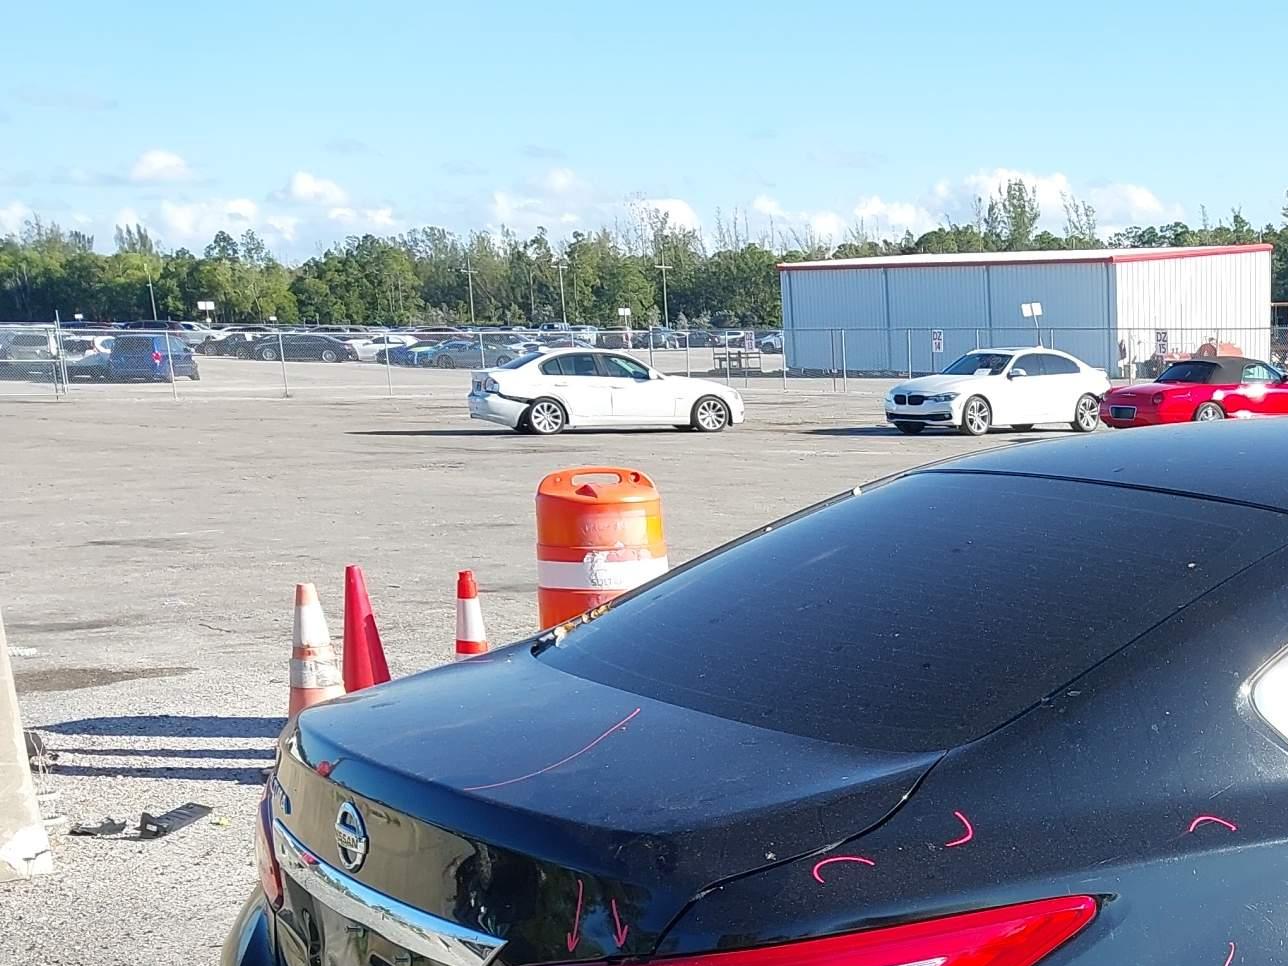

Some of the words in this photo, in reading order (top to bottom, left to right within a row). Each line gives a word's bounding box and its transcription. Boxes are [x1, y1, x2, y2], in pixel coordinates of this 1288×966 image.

[932, 331, 942, 341] DZ
[1156, 332, 1167, 342] DZ
[1158, 343, 1167, 354] 15
